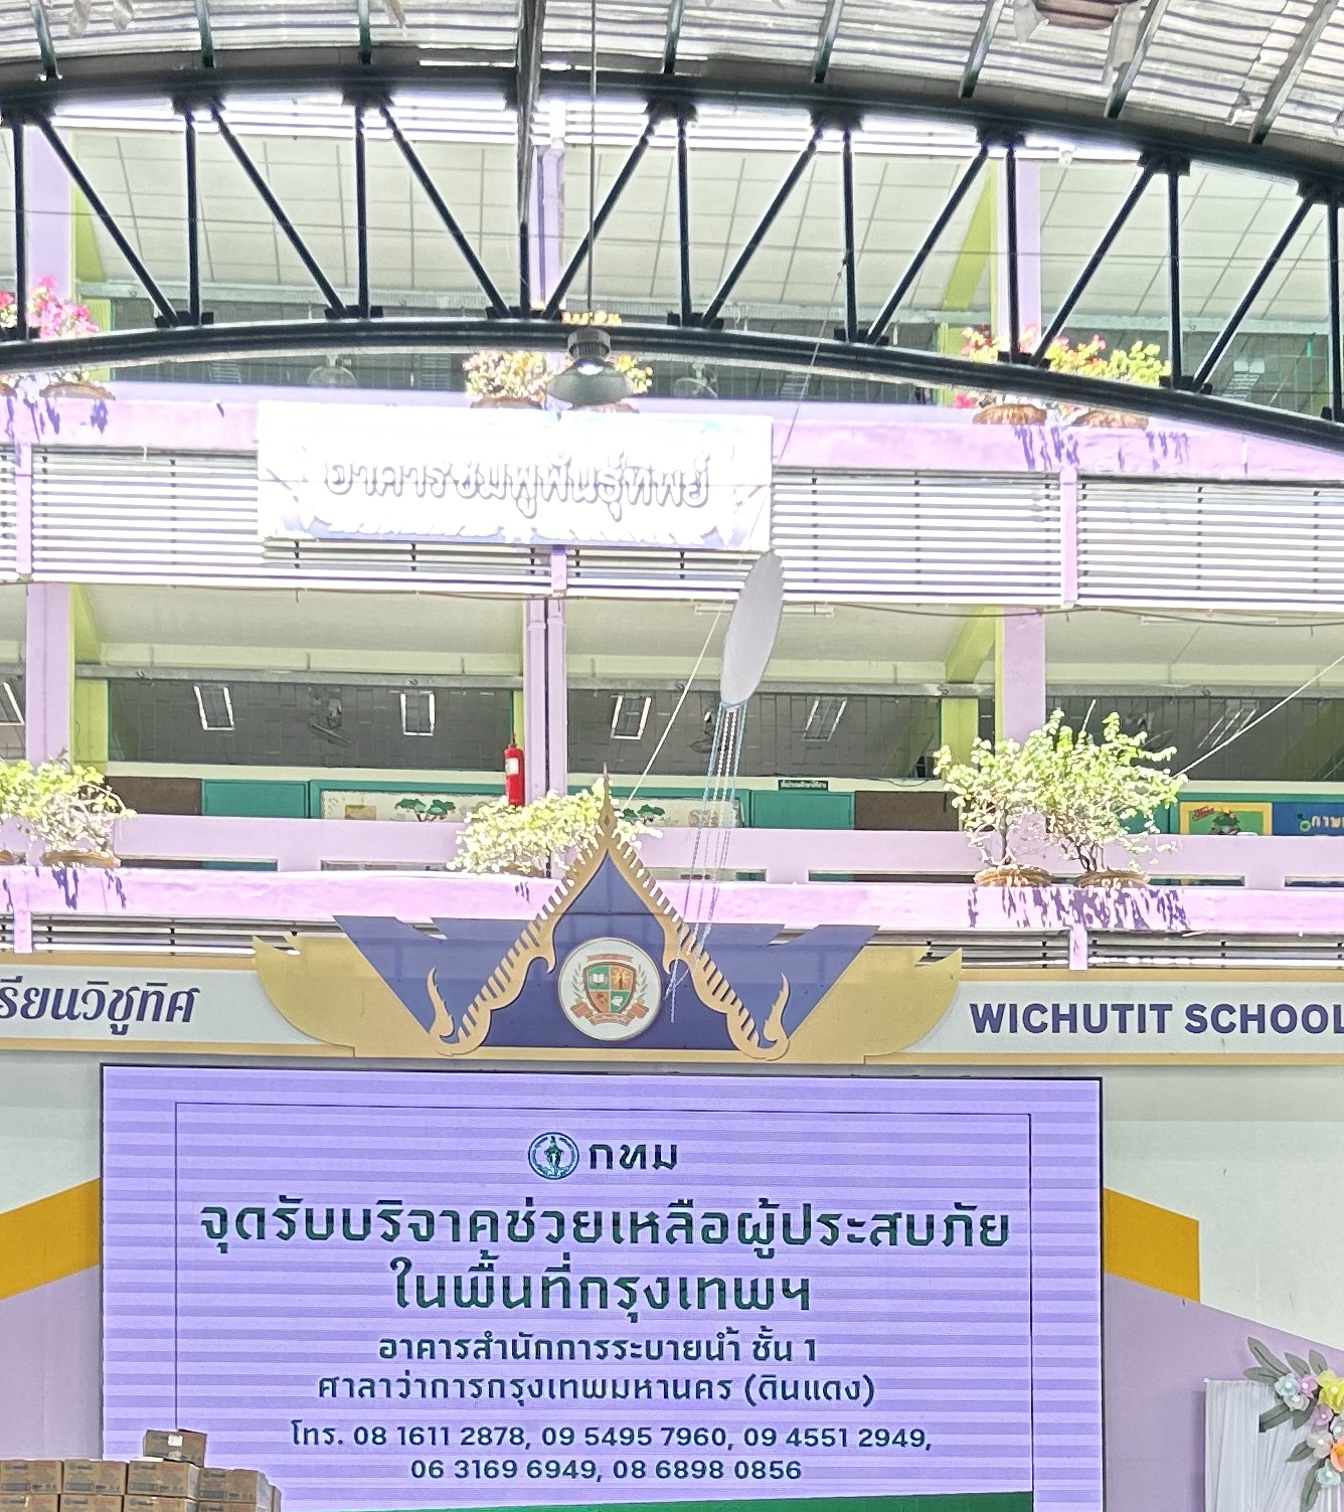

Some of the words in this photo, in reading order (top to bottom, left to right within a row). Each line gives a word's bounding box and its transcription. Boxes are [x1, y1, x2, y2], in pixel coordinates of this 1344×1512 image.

[969, 1003, 1172, 1034] WICHUTIT
[589, 1144, 678, 1170] กทม
[200, 1194, 1010, 1259] จุดรับบริจาคช่วยเหลือผู้ประสบภัย
[389, 1249, 810, 1323] ในพื้นที่กรุงเทพฯ
[379, 1326, 740, 1361] อาคารสำนักการระบายน้ำ
[752, 1325, 792, 1361] ชั้น
[805, 1338, 816, 1361] 1
[318, 1369, 733, 1407] ศาลาว่าการกรุงเทพมหานคร
[744, 1374, 875, 1407] (ดินแดง)
[290, 1419, 344, 1446] โทร.
[353, 1426, 387, 1446] 08
[397, 1426, 450, 1446] 1611
[460, 1426, 531, 1450] 2878,
[542, 1427, 575, 1446] 09
[584, 1427, 652, 1447] 5495
[660, 1427, 733, 1451] 7960,
[744, 1427, 777, 1447] 09
[786, 1428, 848, 1447] 4551
[858, 1428, 931, 1451] 2949,
[411, 1460, 444, 1479] 06
[454, 1460, 517, 1479] 3169
[526, 1460, 602, 1483] 6949,
[613, 1460, 646, 1479] 08
[656, 1460, 724, 1480] 6898
[734, 1460, 802, 1480] 0856
